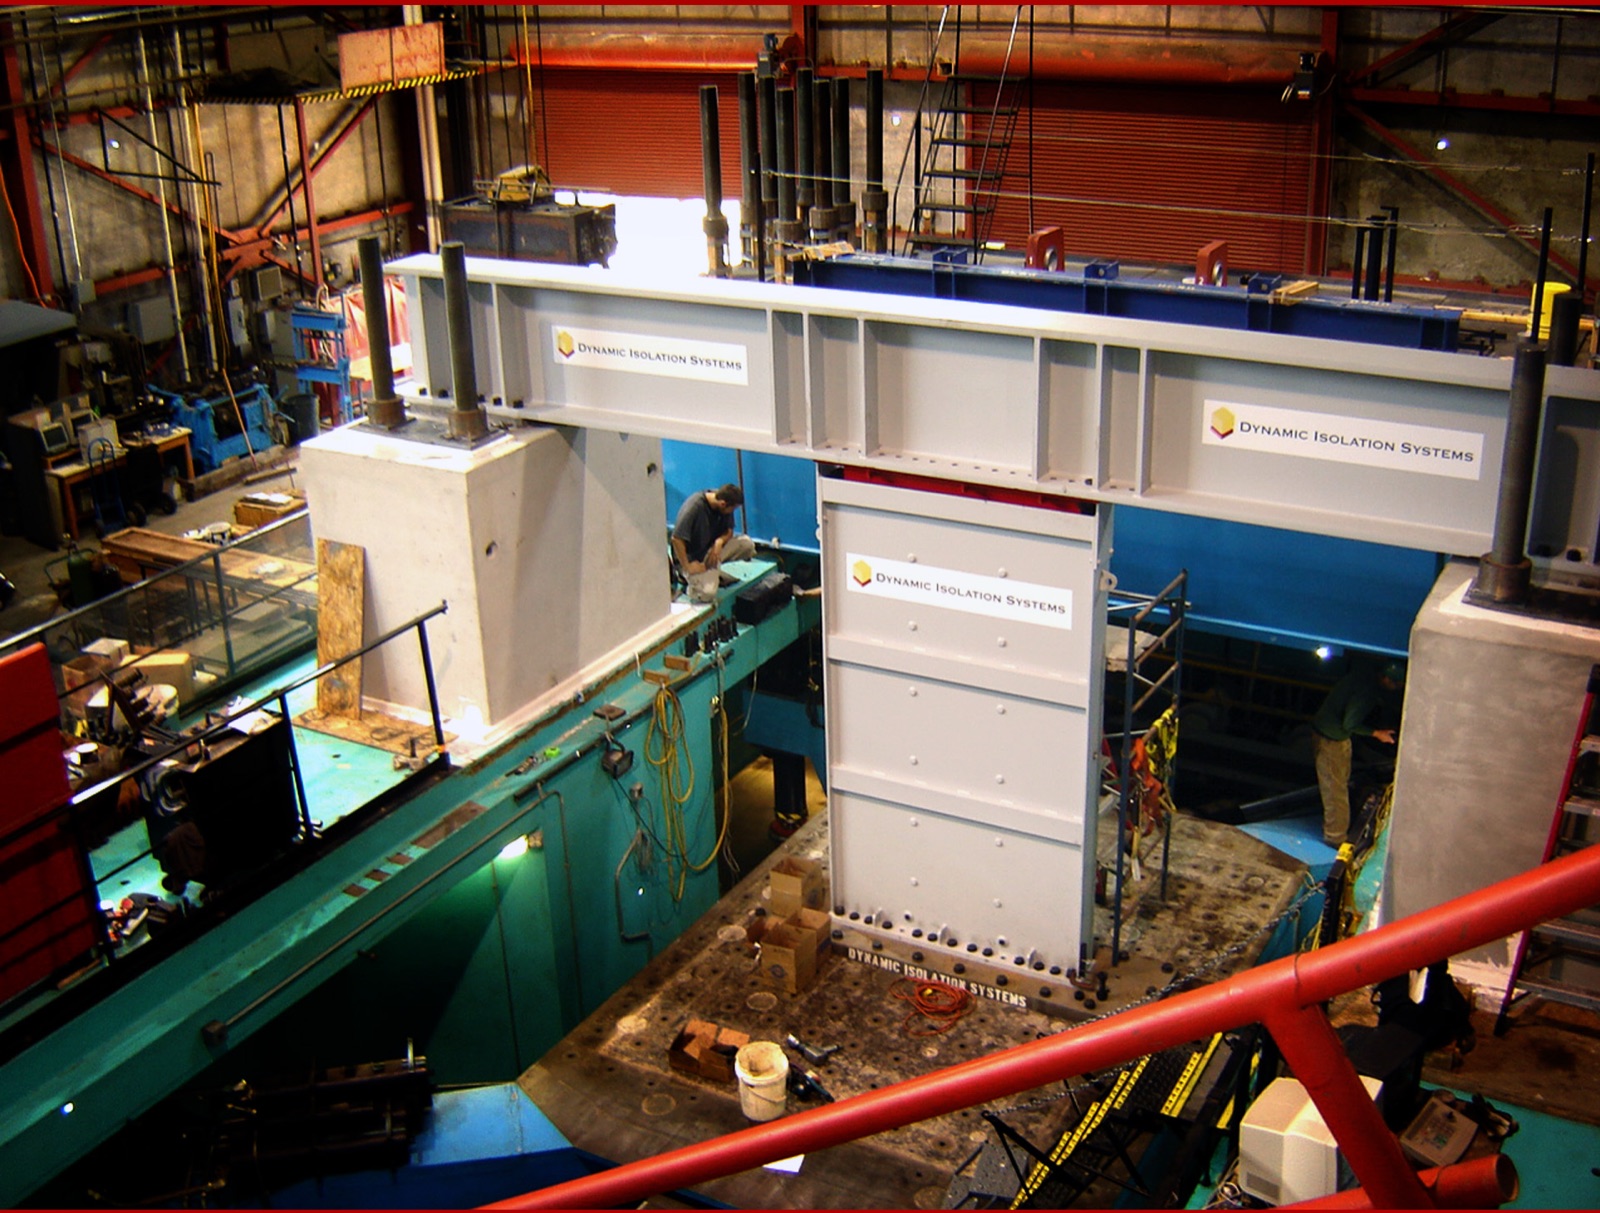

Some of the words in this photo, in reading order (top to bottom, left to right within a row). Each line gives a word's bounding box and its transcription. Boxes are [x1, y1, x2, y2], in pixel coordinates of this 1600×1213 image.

[578, 342, 626, 357] DYNAMIC
[630, 348, 687, 364] ISOLATION
[690, 356, 742, 370] SYSTEMS
[1240, 421, 1308, 440] DYNAMIC
[1314, 430, 1395, 451] ISOLATION
[1401, 442, 1474, 462] SYSTEMS
[876, 572, 931, 591] DYNAMIC
[936, 582, 1001, 603] ISOLATION
[1006, 595, 1066, 614] SYSTEMS
[848, 948, 900, 972] DYNAMIC
[904, 964, 967, 990] ISOLATION
[970, 982, 1027, 1007] SYSTEMS
